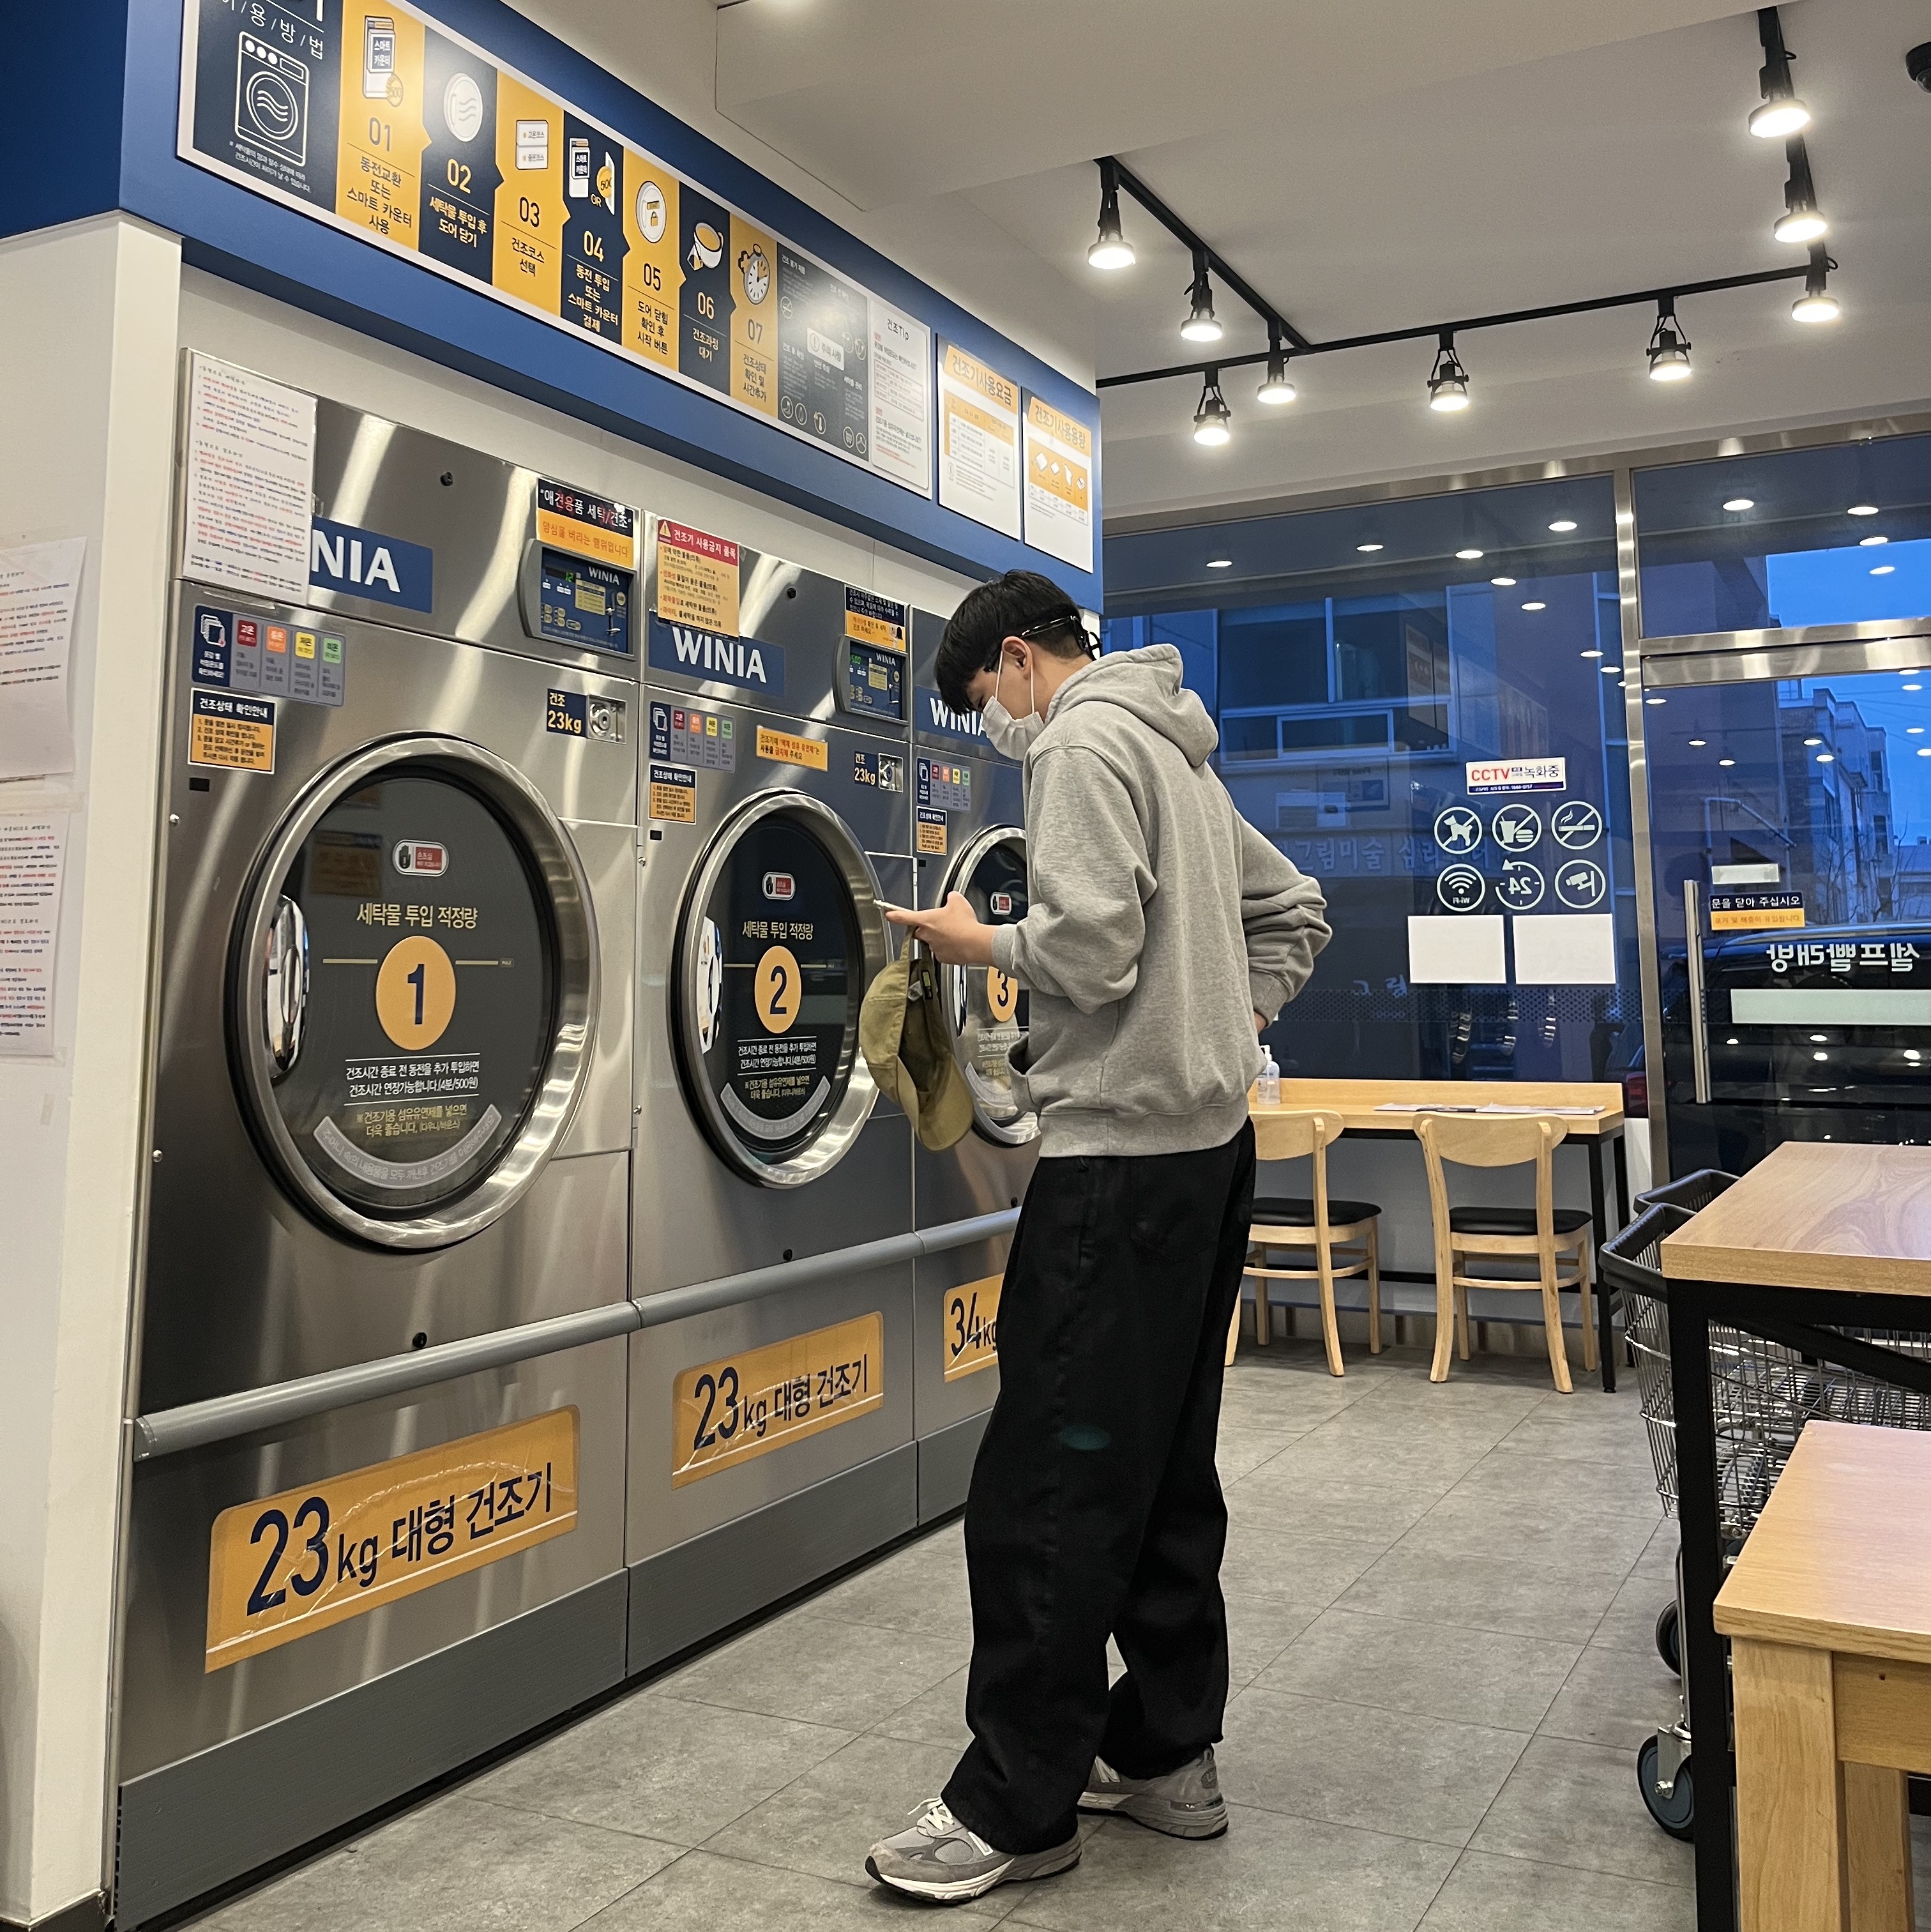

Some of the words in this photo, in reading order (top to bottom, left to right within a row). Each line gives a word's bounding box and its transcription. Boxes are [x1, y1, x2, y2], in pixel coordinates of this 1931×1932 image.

[369, 117, 391, 153] 01
[361, 156, 401, 188] 동전교환
[447, 158, 472, 193] 02
[370, 179, 391, 200] 또는
[347, 186, 377, 213] 스마트
[382, 204, 413, 229] 카운터
[430, 196, 457, 220] 세탁물
[459, 206, 476, 228] 투입
[477, 217, 487, 234] 후
[519, 196, 540, 227] 03
[369, 215, 390, 235] 사용
[439, 220, 458, 237] 도어
[459, 229, 477, 247] 닫기
[511, 237, 545, 264] 건조코스
[584, 231, 604, 262] 04
[520, 258, 536, 277] 선택
[576, 264, 593, 284] 동전
[594, 273, 610, 292] 투입
[644, 263, 662, 291] 05
[586, 286, 601, 303] 또는
[697, 291, 715, 319] 06
[568, 291, 593, 313] 스마트
[594, 305, 618, 326] 카운터
[638, 301, 652, 318] 도어
[654, 308, 669, 326] 닫힘
[584, 315, 600, 333] 결제
[641, 317, 657, 335] 확인
[658, 325, 665, 338] 후
[748, 319, 764, 344] 07
[887, 318, 909, 342] 건조Tip
[638, 331, 652, 348] 시작
[653, 338, 669, 355] 버튼
[693, 328, 719, 351] 건조과정
[699, 346, 713, 361] 대기
[745, 367, 759, 382] 확인
[953, 354, 1013, 407] 건조기사용요금
[743, 381, 767, 402] 시간추가
[568, 529, 591, 546] 버리는
[674, 529, 694, 546] 건조기
[696, 537, 722, 555] 사용금지
[312, 529, 401, 593] NIA
[588, 567, 620, 586] WINIA
[672, 626, 767, 684] WINIA
[875, 652, 897, 667] WINIA
[200, 697, 233, 713] 건조상태
[236, 703, 268, 719] 확인안내
[549, 693, 566, 706] 건조
[547, 710, 582, 734] 23kg
[789, 750, 803, 760] 주세요
[855, 754, 866, 765] 건조
[854, 768, 875, 785] 23kg
[1471, 768, 1510, 781] CCTV
[1524, 764, 1560, 779] 녹화중
[1711, 898, 1731, 909] 문을
[1735, 897, 1755, 908] 닫아
[1759, 895, 1801, 908] 주십시오
[357, 902, 402, 927] 세탁물
[405, 905, 434, 928] 투입
[438, 906, 479, 929] 적정량
[742, 920, 768, 940] 세탁물
[770, 921, 788, 940] 투입
[789, 922, 814, 941] 적정량
[407, 963, 425, 1026] 1
[769, 964, 788, 1015] 2
[997, 969, 1009, 1007] 3
[345, 1066, 379, 1080] 건조시간
[380, 1065, 397, 1079] 종료
[398, 1064, 407, 1077] 전
[409, 1063, 432, 1077] 동전을
[434, 1061, 450, 1075] 추가
[450, 1060, 480, 1074] 투입하면
[349, 1083, 382, 1098] 건조시간
[398, 1106, 444, 1122] 섬유유연제를
[445, 1103, 467, 1116] 넣으면
[366, 1124, 383, 1138] 더욱
[321, 1127, 345, 1156] 주머니
[389, 1169, 406, 1182] 모두
[693, 1366, 767, 1451] 23kg
[775, 1373, 810, 1422] 대형
[817, 1353, 868, 1409] 건조기
[246, 1496, 379, 1616] 23kg
[391, 1494, 455, 1563] 대형
[466, 1462, 552, 1541] 건조기
